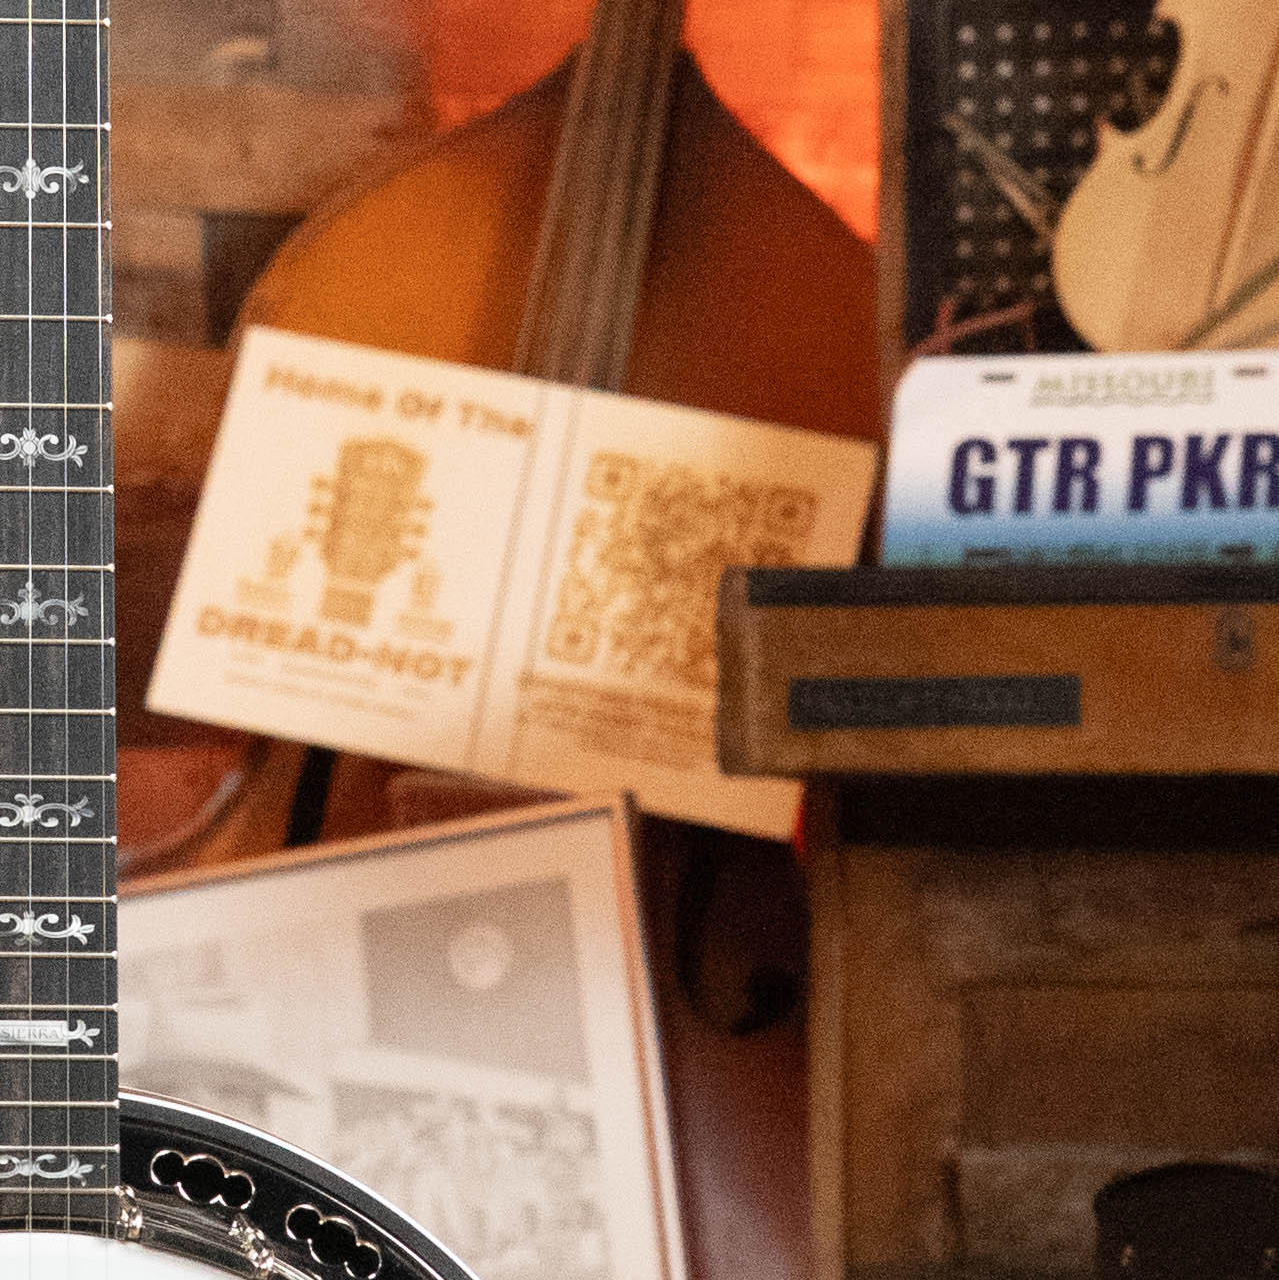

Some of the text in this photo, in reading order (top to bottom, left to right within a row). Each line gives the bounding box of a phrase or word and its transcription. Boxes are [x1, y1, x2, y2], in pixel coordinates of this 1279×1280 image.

[457, 401, 535, 439] The
[947, 432, 1279, 516] GTR PKR
[196, 604, 476, 686] DREAD-NOT
